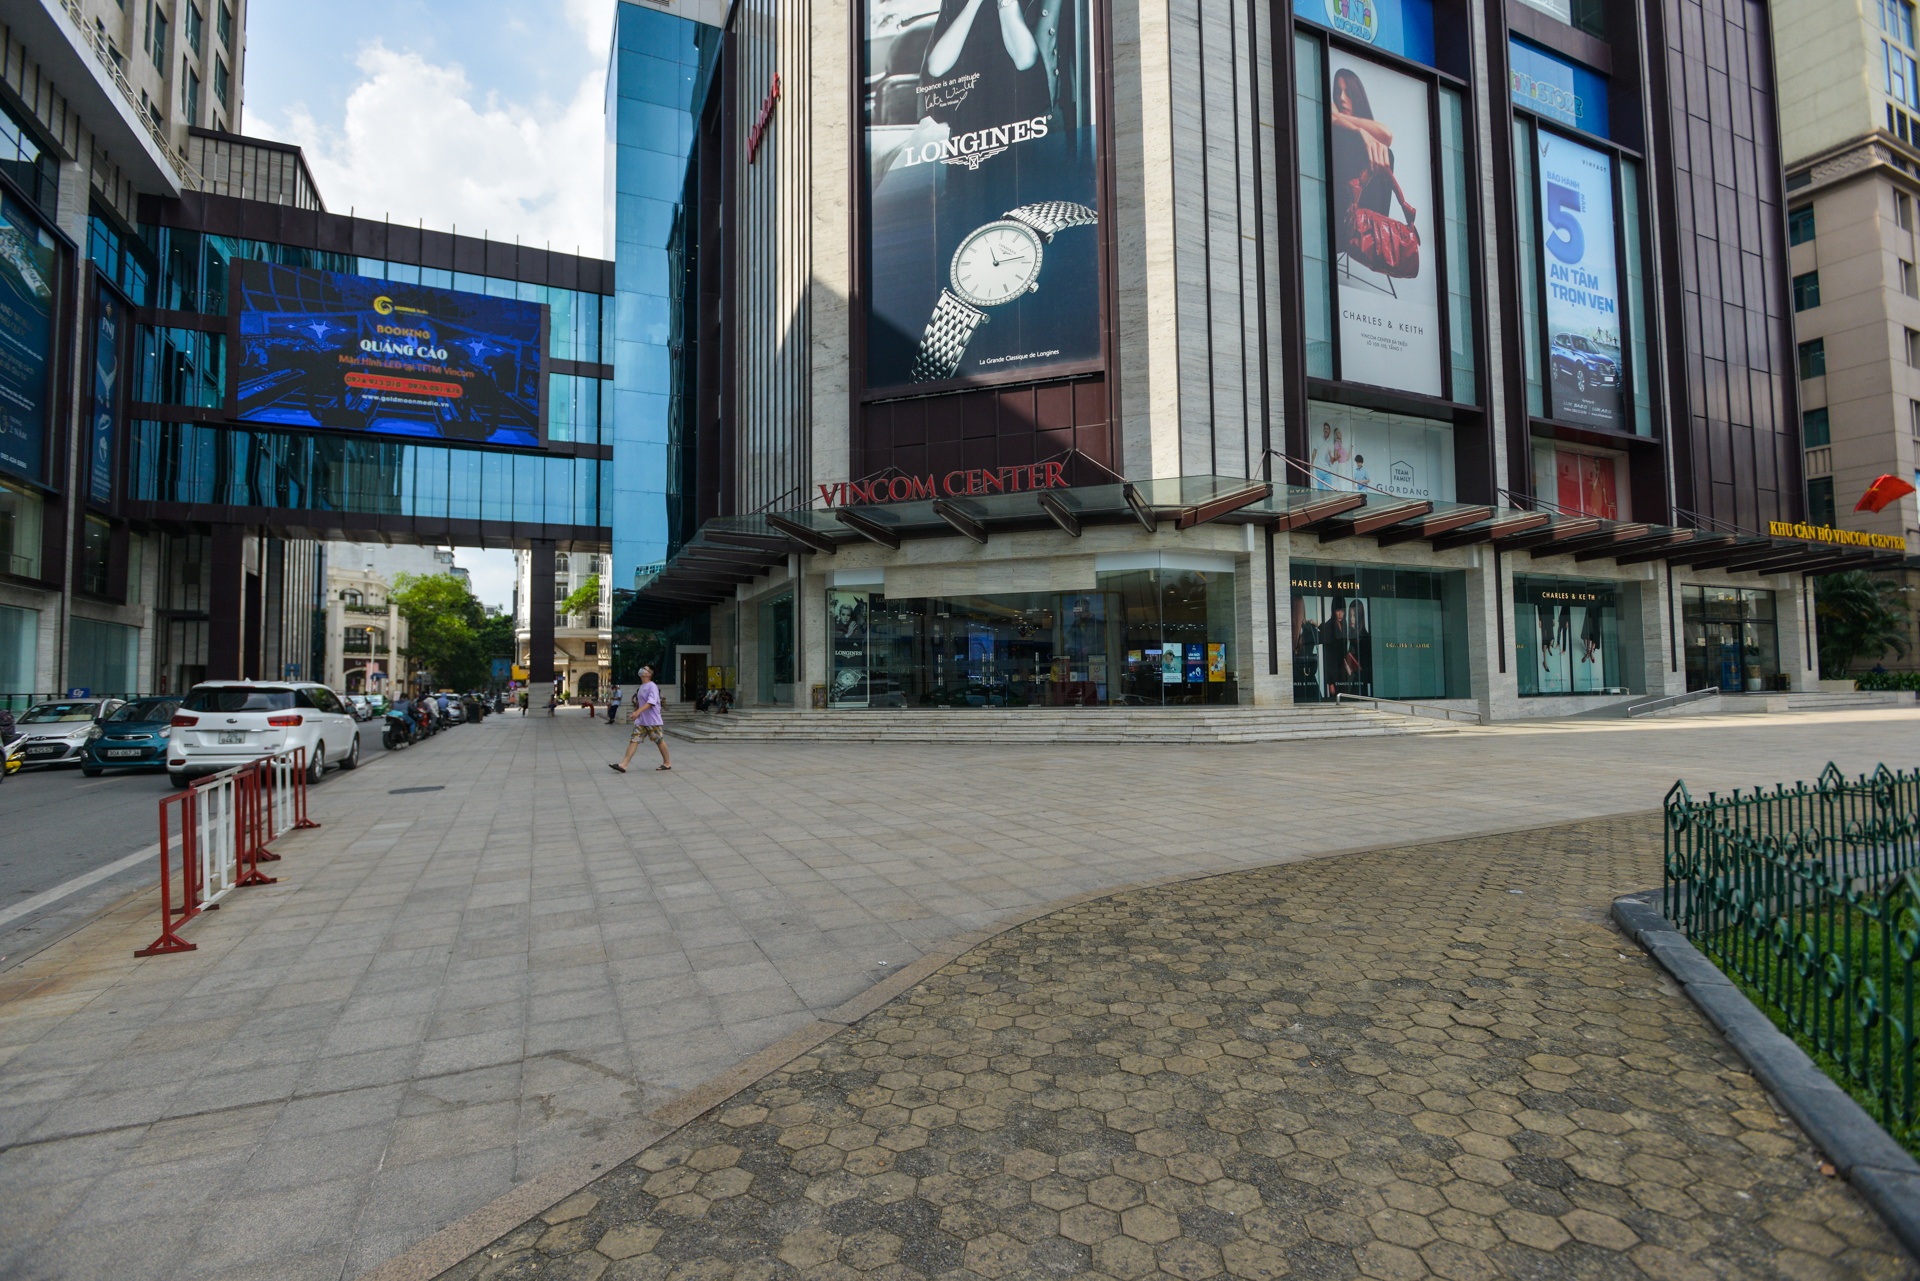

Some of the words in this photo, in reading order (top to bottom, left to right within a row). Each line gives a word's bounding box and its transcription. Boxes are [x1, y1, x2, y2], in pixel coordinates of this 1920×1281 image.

[1334, 16, 1371, 40] WORLD
[916, 82, 942, 94] Elegance
[958, 72, 981, 84] attitude
[905, 116, 1048, 167] LONGINES
[1582, 160, 1607, 173] VINFAST
[1546, 180, 1585, 264] 5
[1550, 264, 1569, 282] AN
[1570, 266, 1599, 290] TÂM
[1550, 282, 1586, 308] TRỌN
[1588, 292, 1614, 314] VẸN
[102, 316, 115, 340] PNJ
[376, 324, 430, 340] BOOKING
[1342, 310, 1382, 326] CHARLES
[1388, 320, 1393, 328] &
[1399, 322, 1424, 335] KEITH
[1361, 333, 1376, 341] VINCOM
[1378, 336, 1391, 344] CENTER
[986, 356, 1004, 364] Grande
[1006, 353, 1028, 362] Classique
[1037, 349, 1060, 358] Longines
[384, 359, 402, 370] LED
[444, 367, 475, 378] Vincom
[818, 473, 938, 509] VINCOM
[943, 462, 1070, 496] CENTER
[1376, 484, 1429, 497] GIORDANO
[1769, 521, 1793, 537] KHU
[1817, 524, 1833, 544] HỘ
[1832, 529, 1870, 546] VINCOM
[1871, 534, 1906, 550] CENTER
[1327, 581, 1333, 589] &
[1337, 581, 1360, 590] KEITH
[1542, 591, 1569, 599] CHARLES
